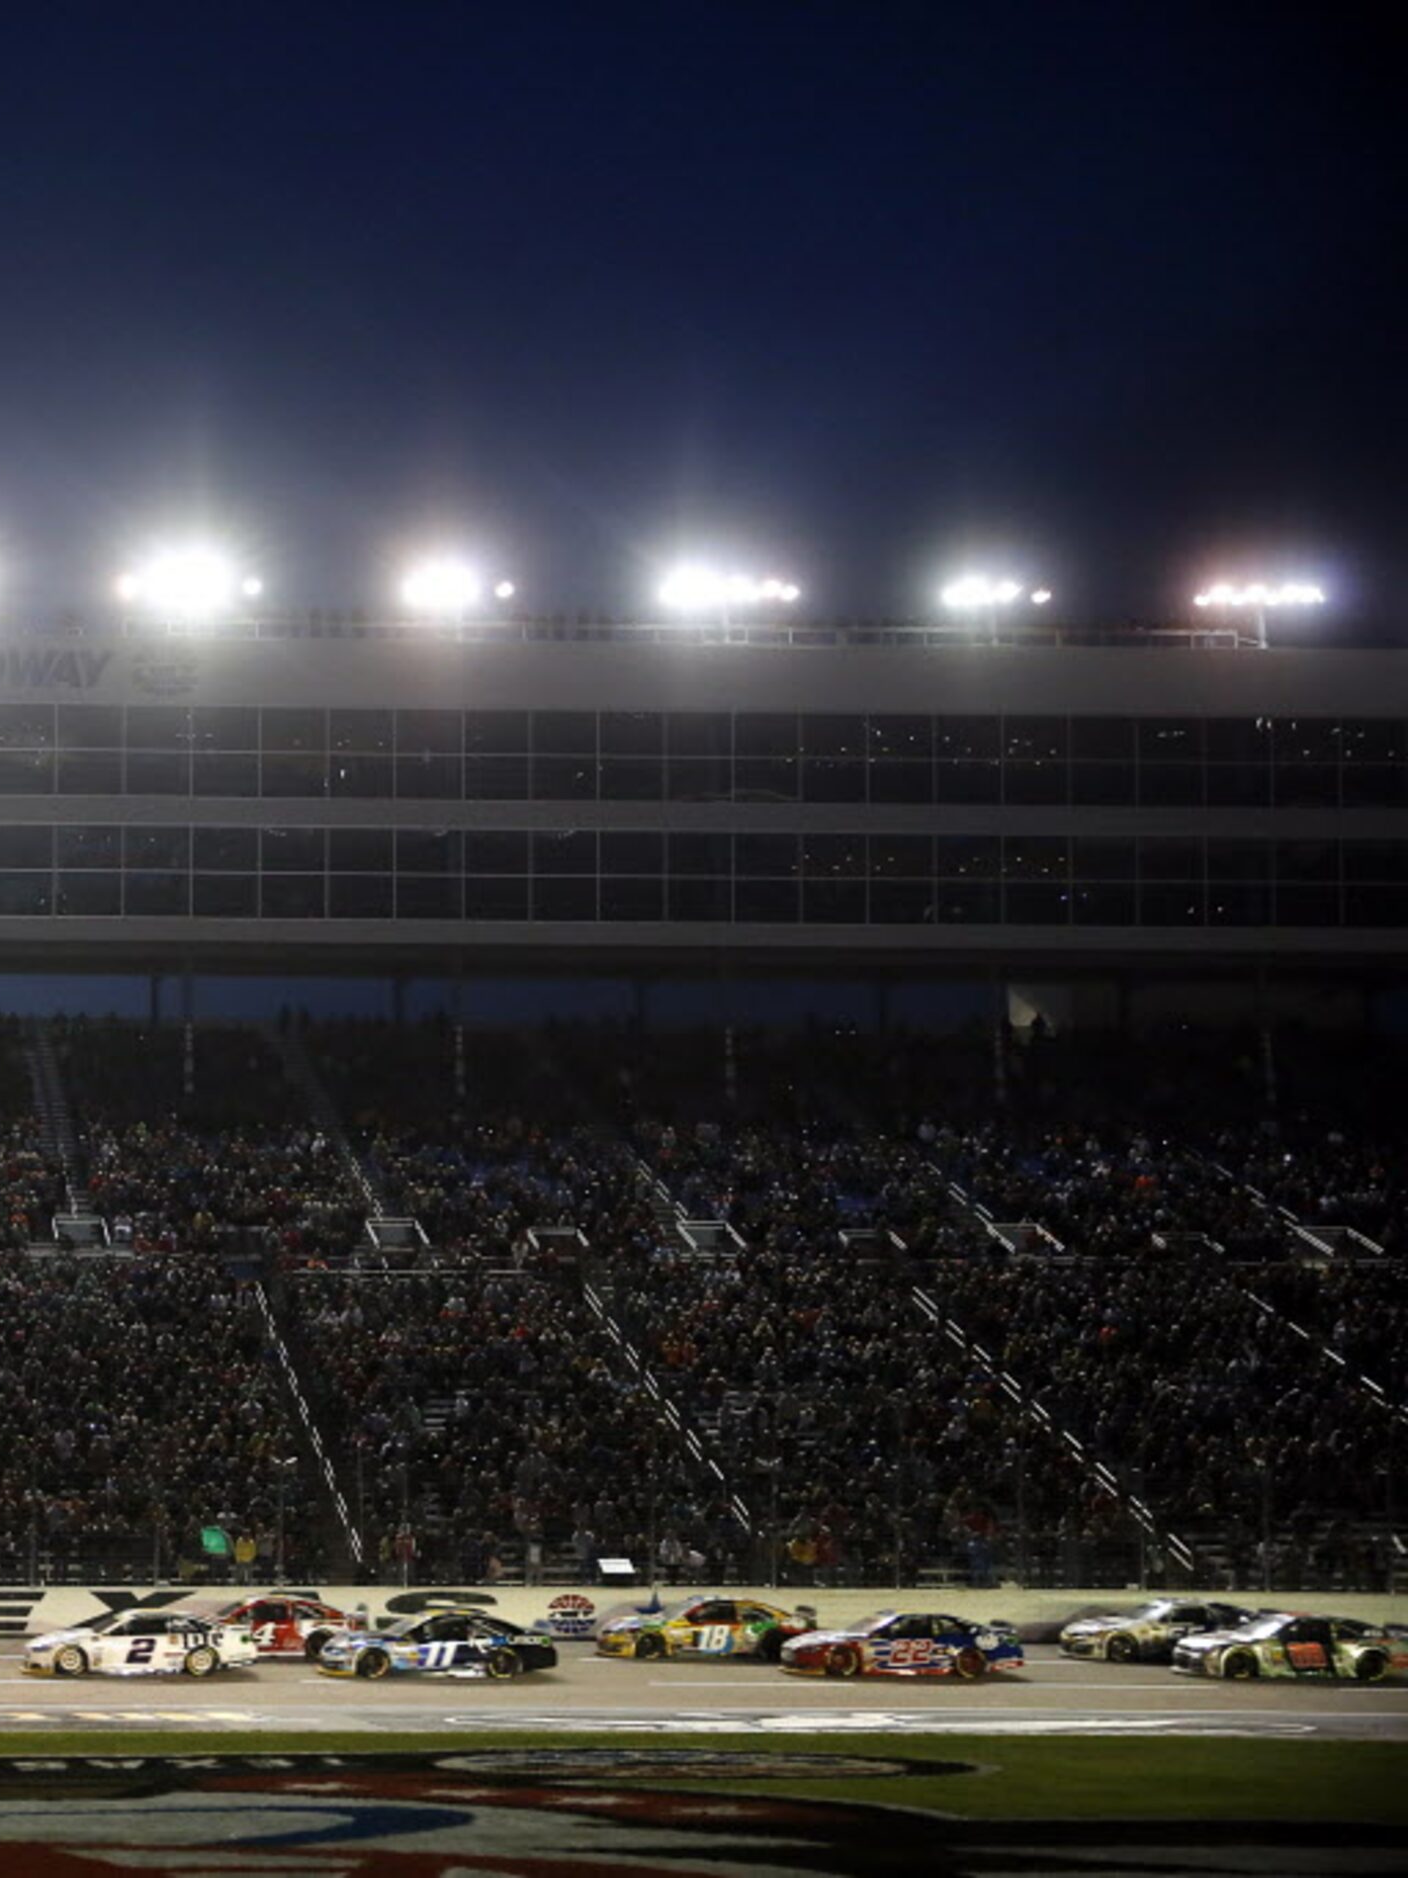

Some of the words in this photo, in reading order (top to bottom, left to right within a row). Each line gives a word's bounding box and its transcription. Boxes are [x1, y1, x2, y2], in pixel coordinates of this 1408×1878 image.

[253, 1621, 277, 1646] 4
[697, 1625, 727, 1651] 18
[126, 1637, 157, 1664] 2
[424, 1641, 458, 1667] 11
[889, 1638, 933, 1664] 22
